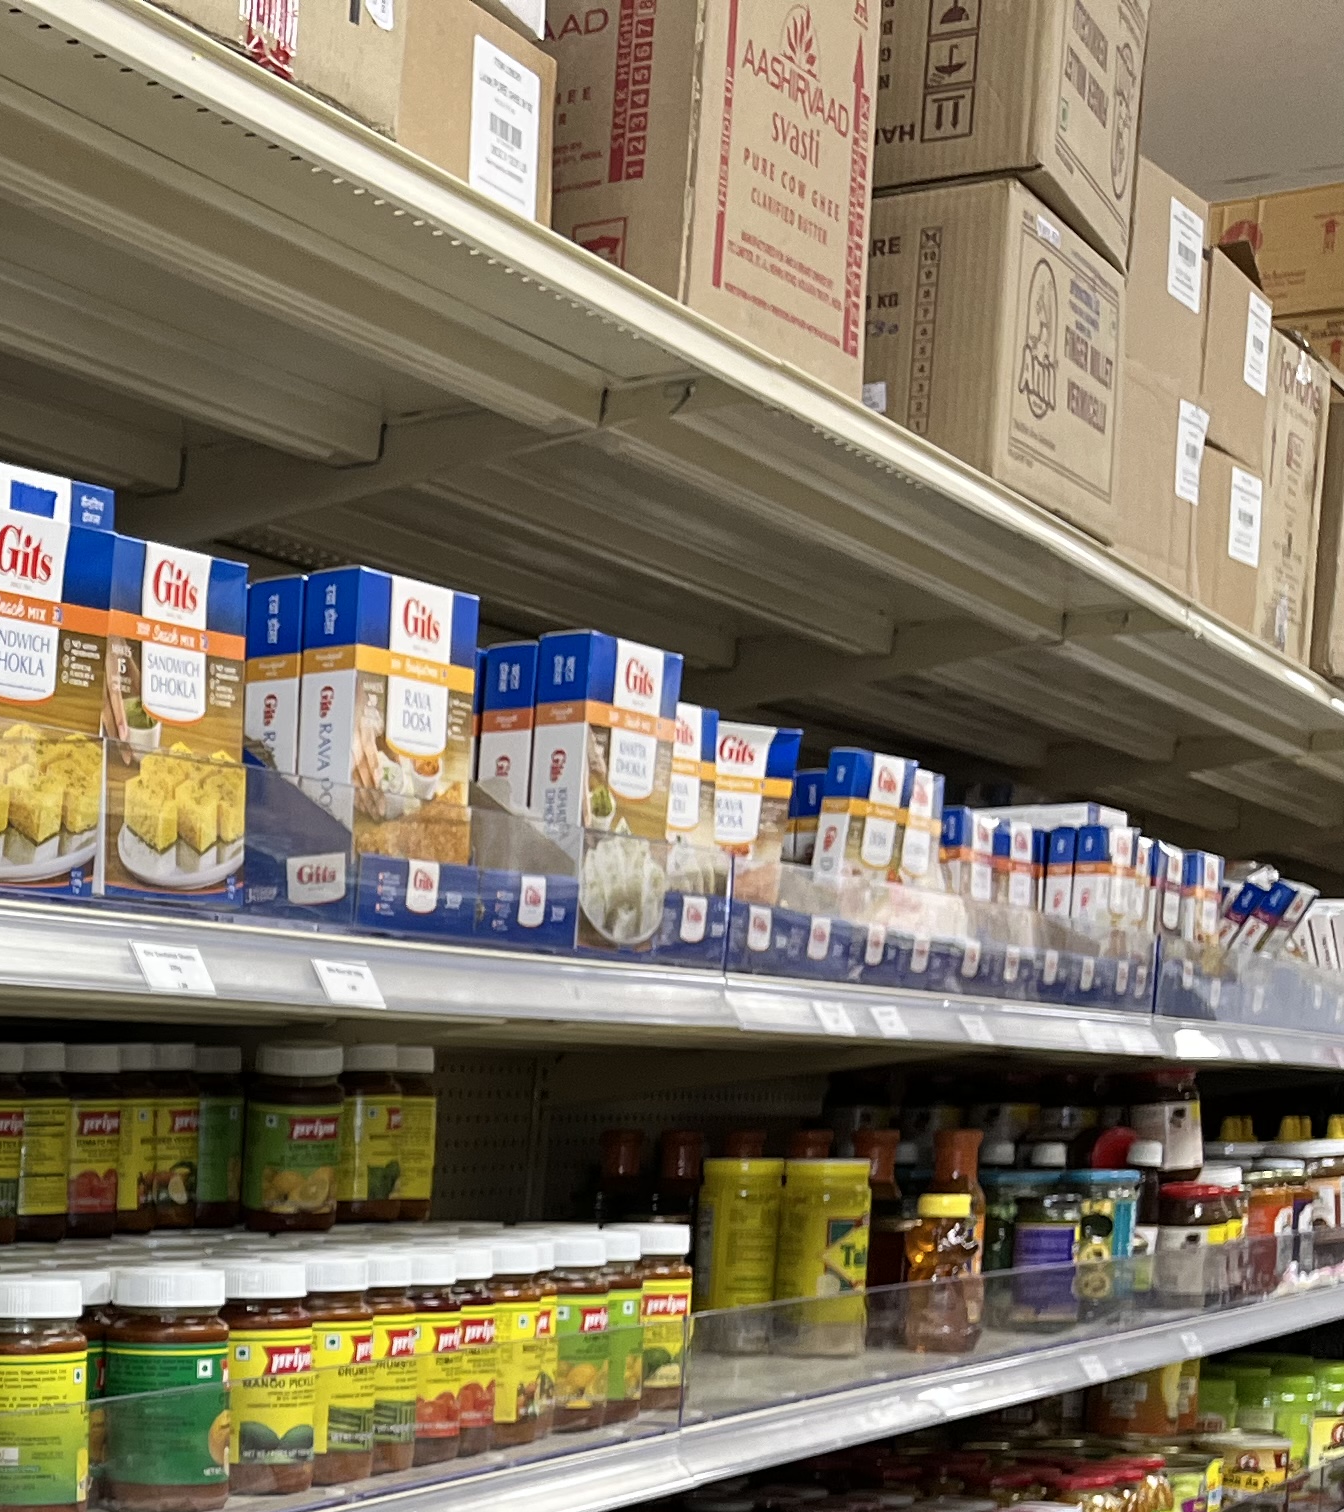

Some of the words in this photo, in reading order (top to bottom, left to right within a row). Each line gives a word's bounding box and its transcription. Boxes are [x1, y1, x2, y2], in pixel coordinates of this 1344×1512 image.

[741, 39, 851, 138] AASHIRVAAD
[772, 112, 821, 169] svasti
[152, 559, 199, 614] Gits
[402, 597, 440, 643] Gits
[146, 653, 200, 679] SANDWICH
[625, 657, 654, 698] Gits
[150, 674, 197, 700] DHOKLA
[403, 688, 433, 713] RAVA
[402, 709, 433, 733] DOSA
[718, 734, 755, 766] Gits
[647, 1295, 689, 1316] priya
